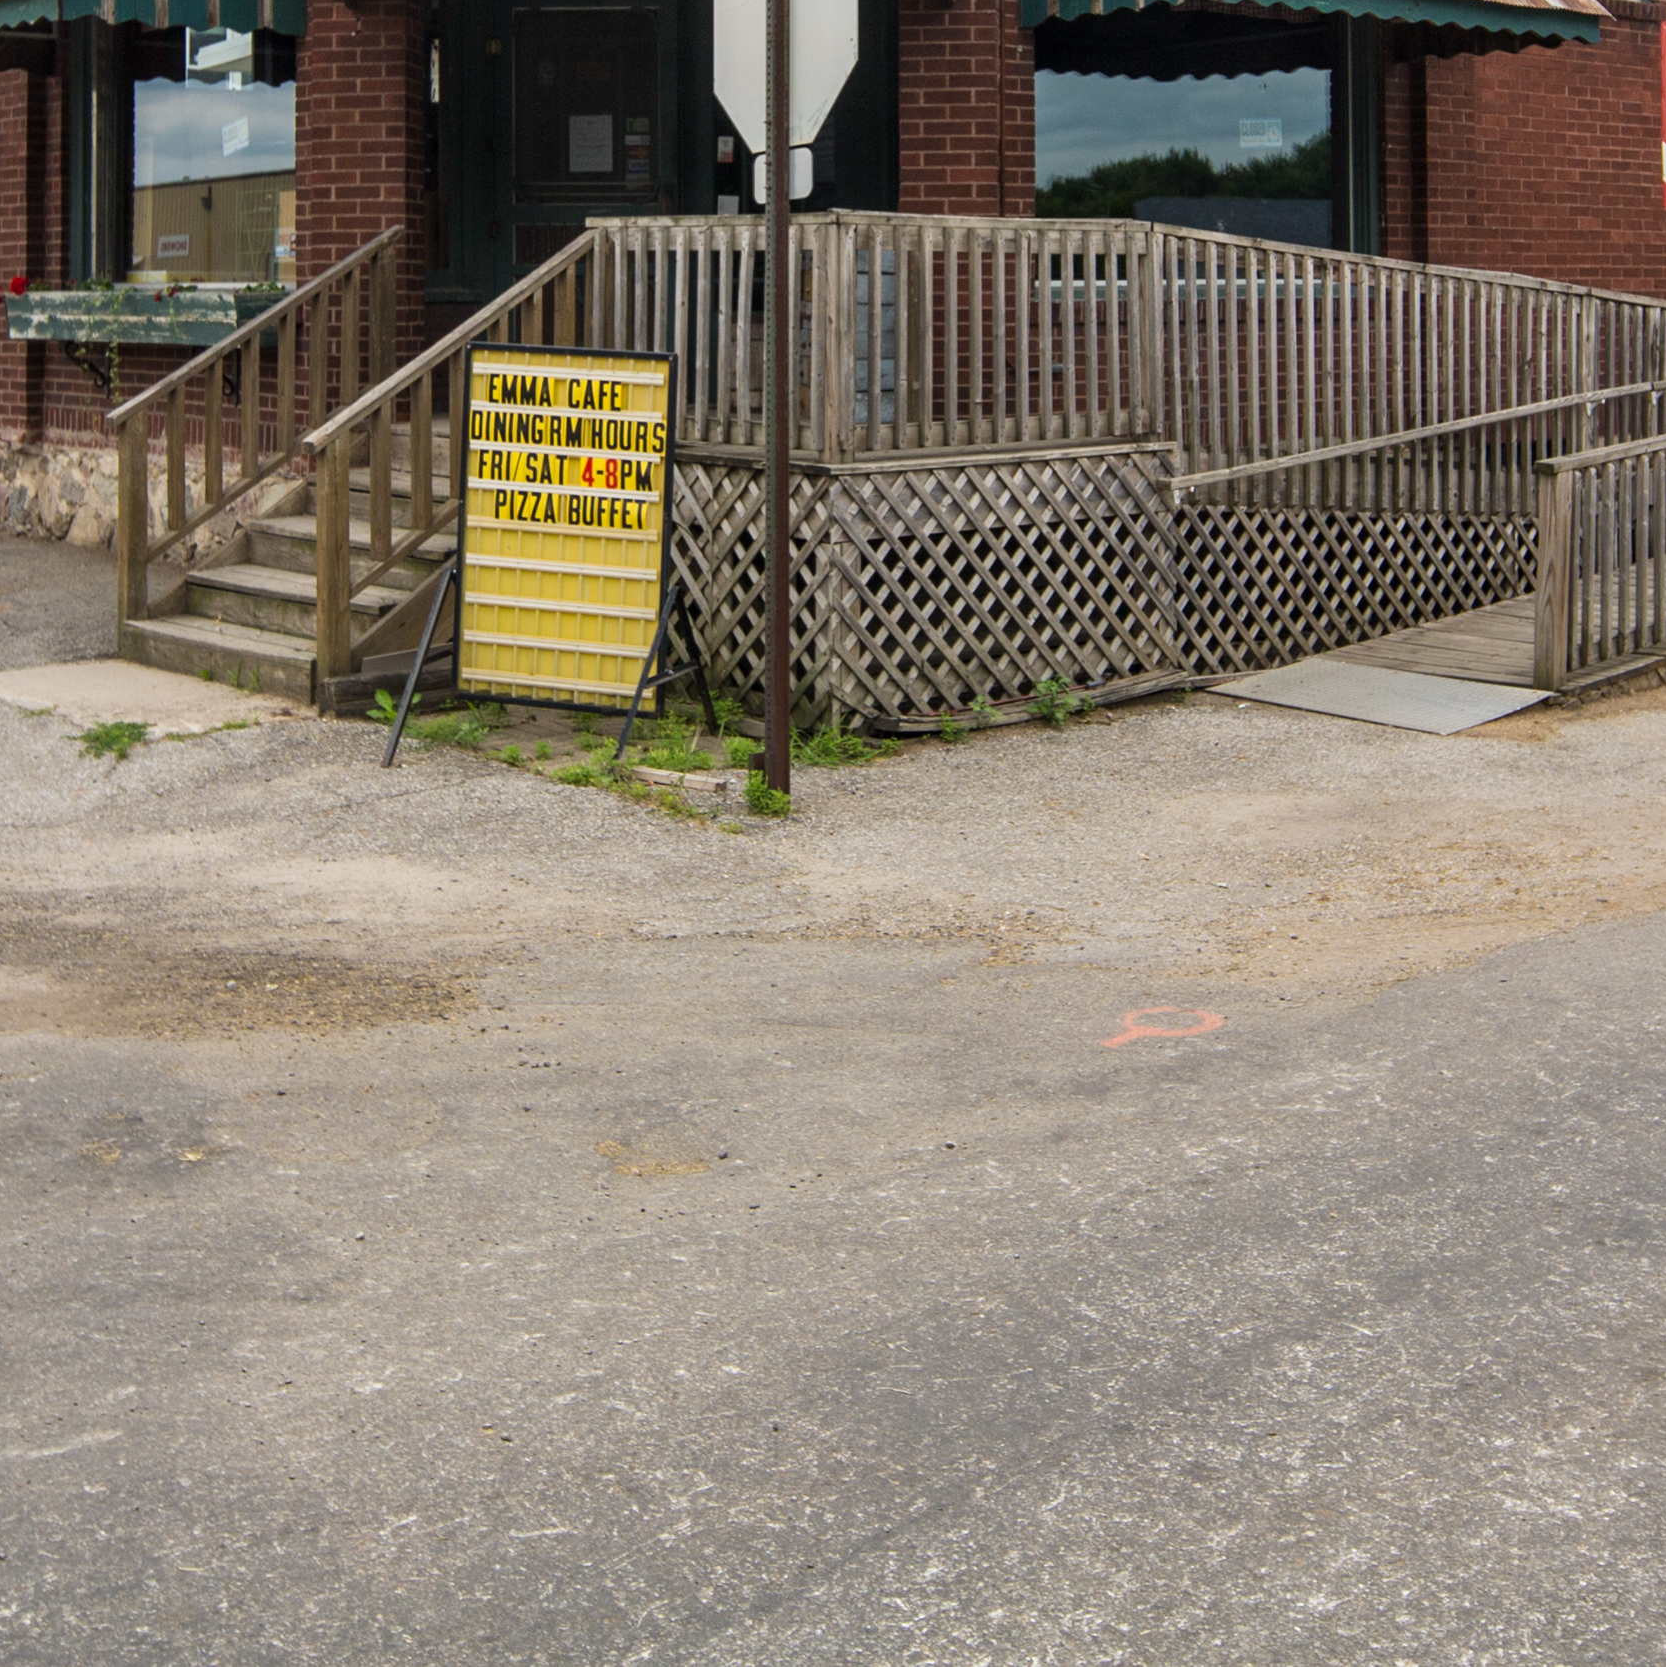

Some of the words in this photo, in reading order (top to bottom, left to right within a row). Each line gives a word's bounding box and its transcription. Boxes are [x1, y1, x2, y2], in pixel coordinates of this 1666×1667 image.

[488, 374, 552, 407] EMMA
[567, 379, 622, 411] CAFE
[470, 410, 543, 445] DINING
[548, 416, 582, 447] RM
[591, 419, 666, 454] HOURS
[478, 450, 568, 485] FRI/SAT
[581, 456, 654, 492] 4-8PM
[494, 489, 557, 523] PIZZA
[567, 494, 647, 530] BUFFET
